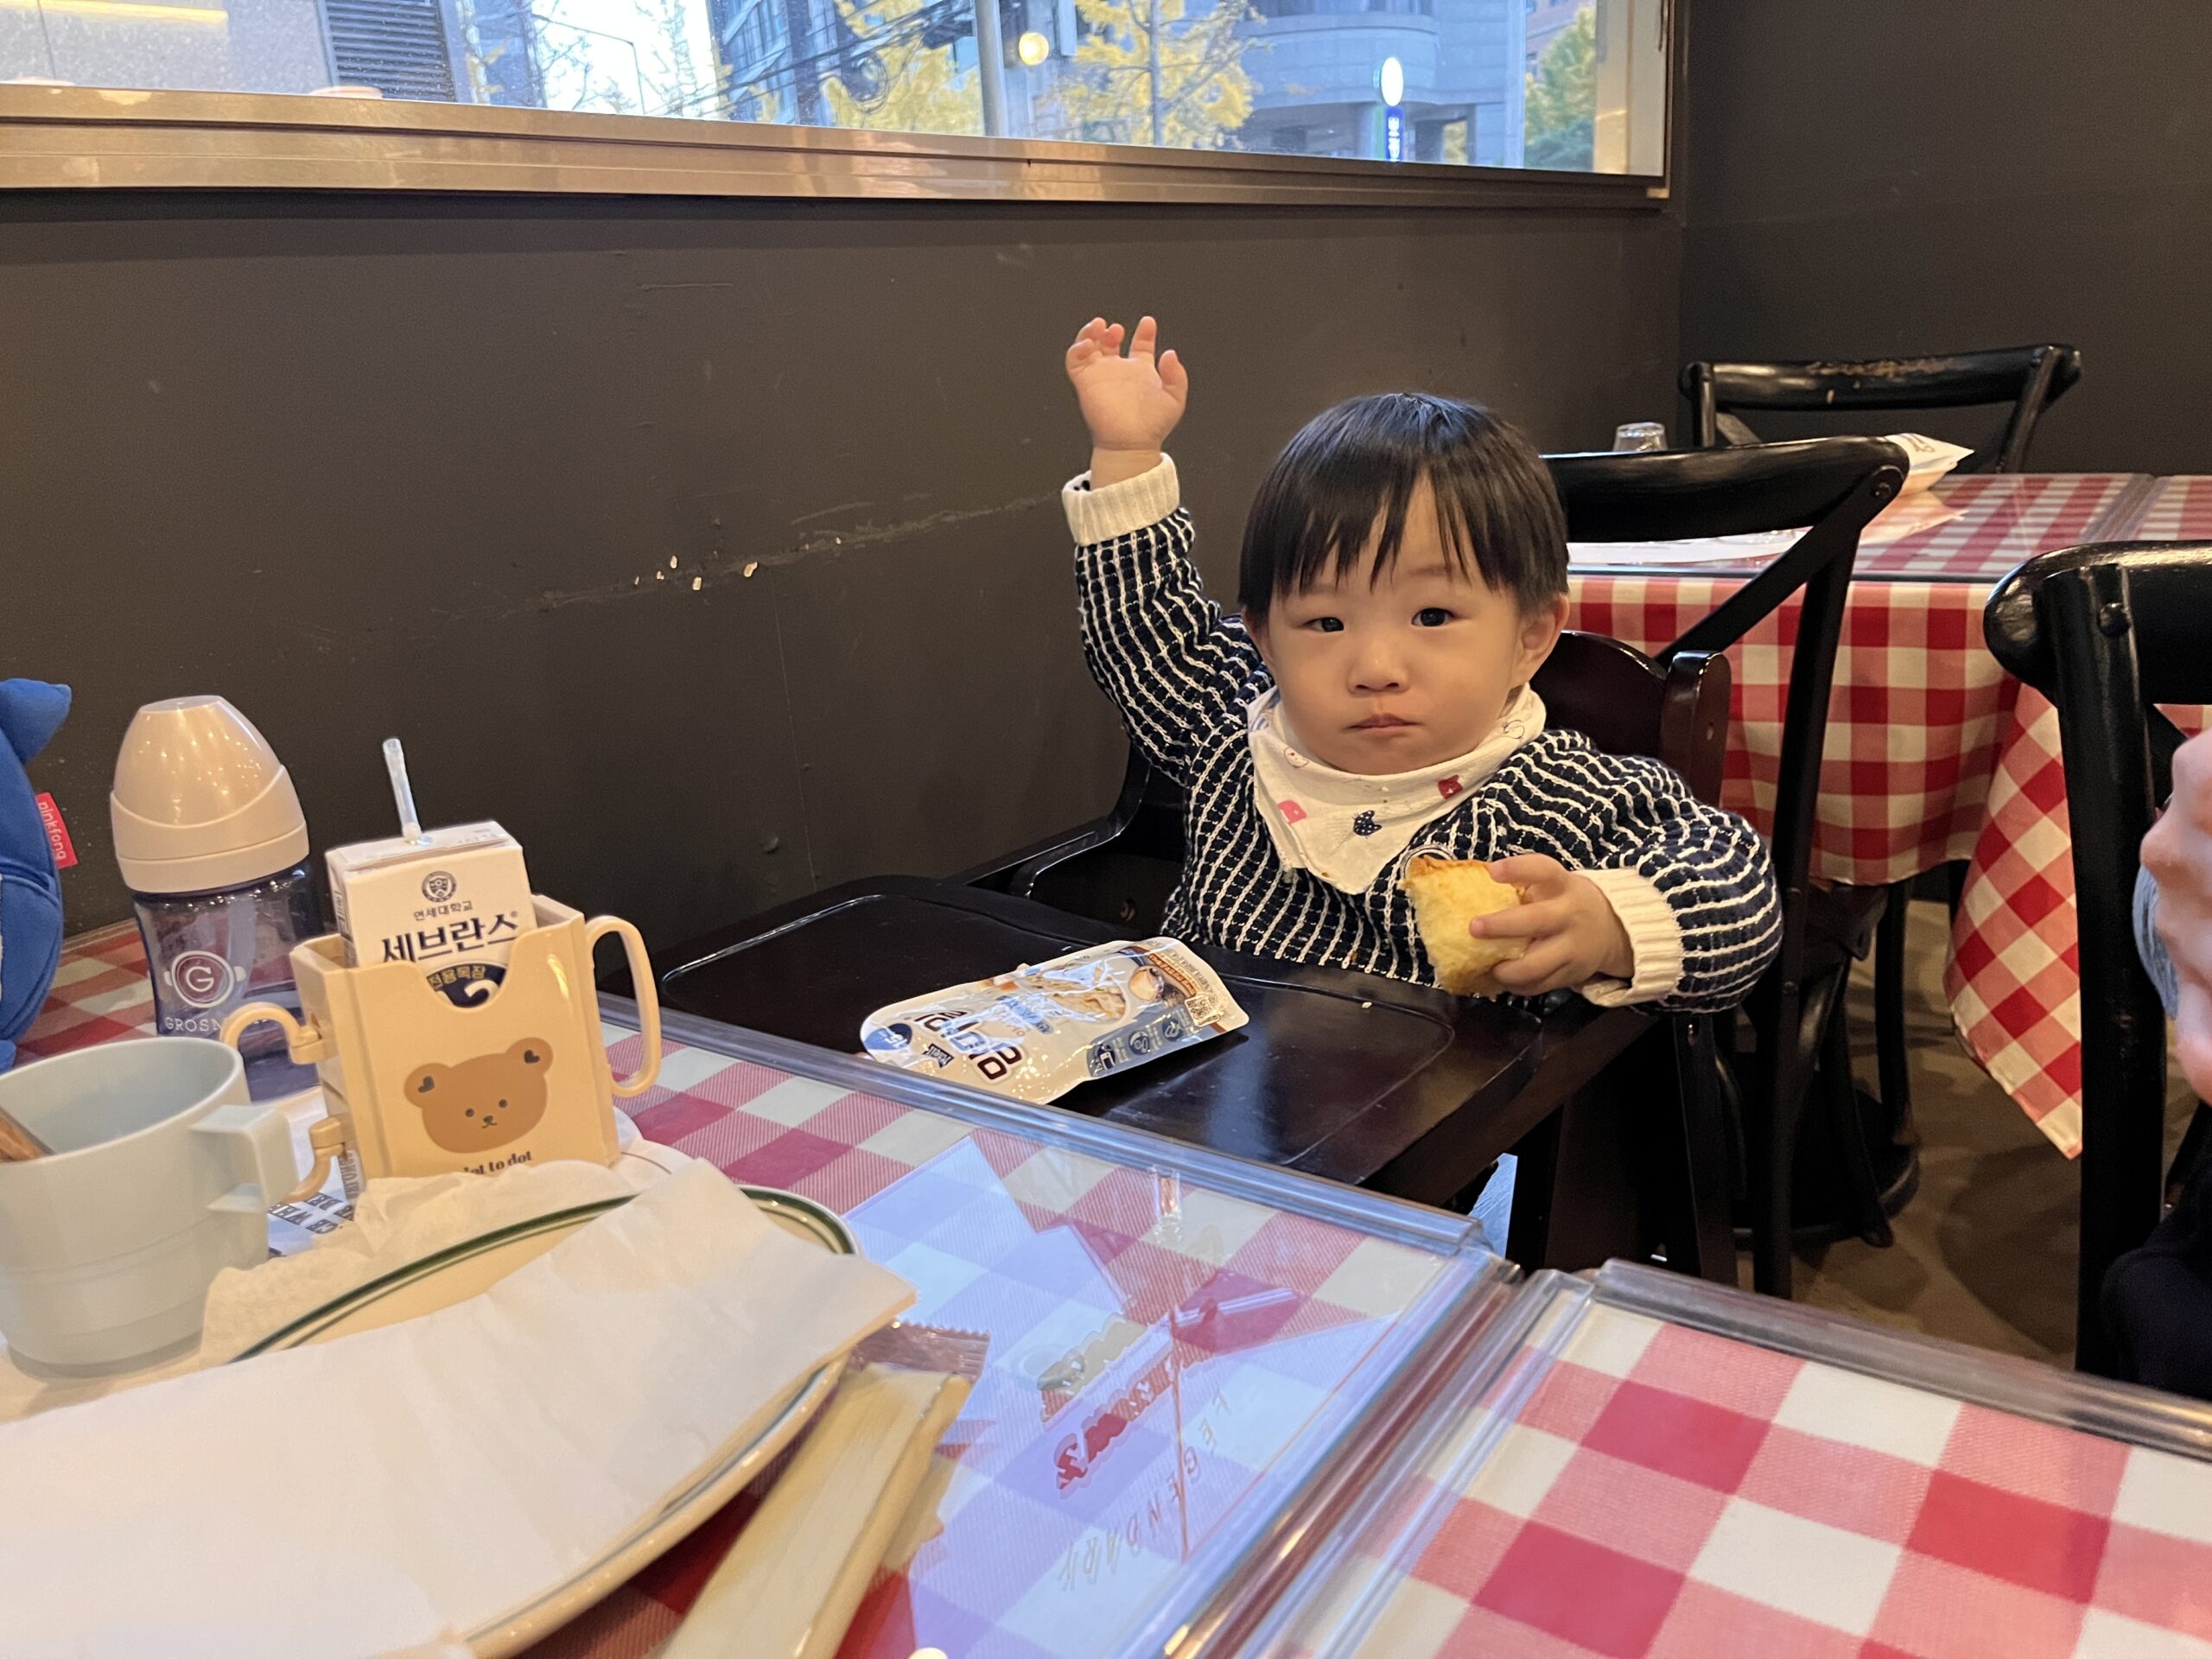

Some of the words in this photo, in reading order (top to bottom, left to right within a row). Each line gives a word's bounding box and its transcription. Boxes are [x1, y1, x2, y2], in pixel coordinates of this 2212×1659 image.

[38, 802, 67, 861] pinkfong
[413, 900, 474, 921] 연세대학교
[381, 913, 518, 963] 세브란스
[185, 966, 214, 992] G
[463, 1164, 486, 1175] ot
[488, 1161, 505, 1173] to
[507, 1150, 532, 1167] dot
